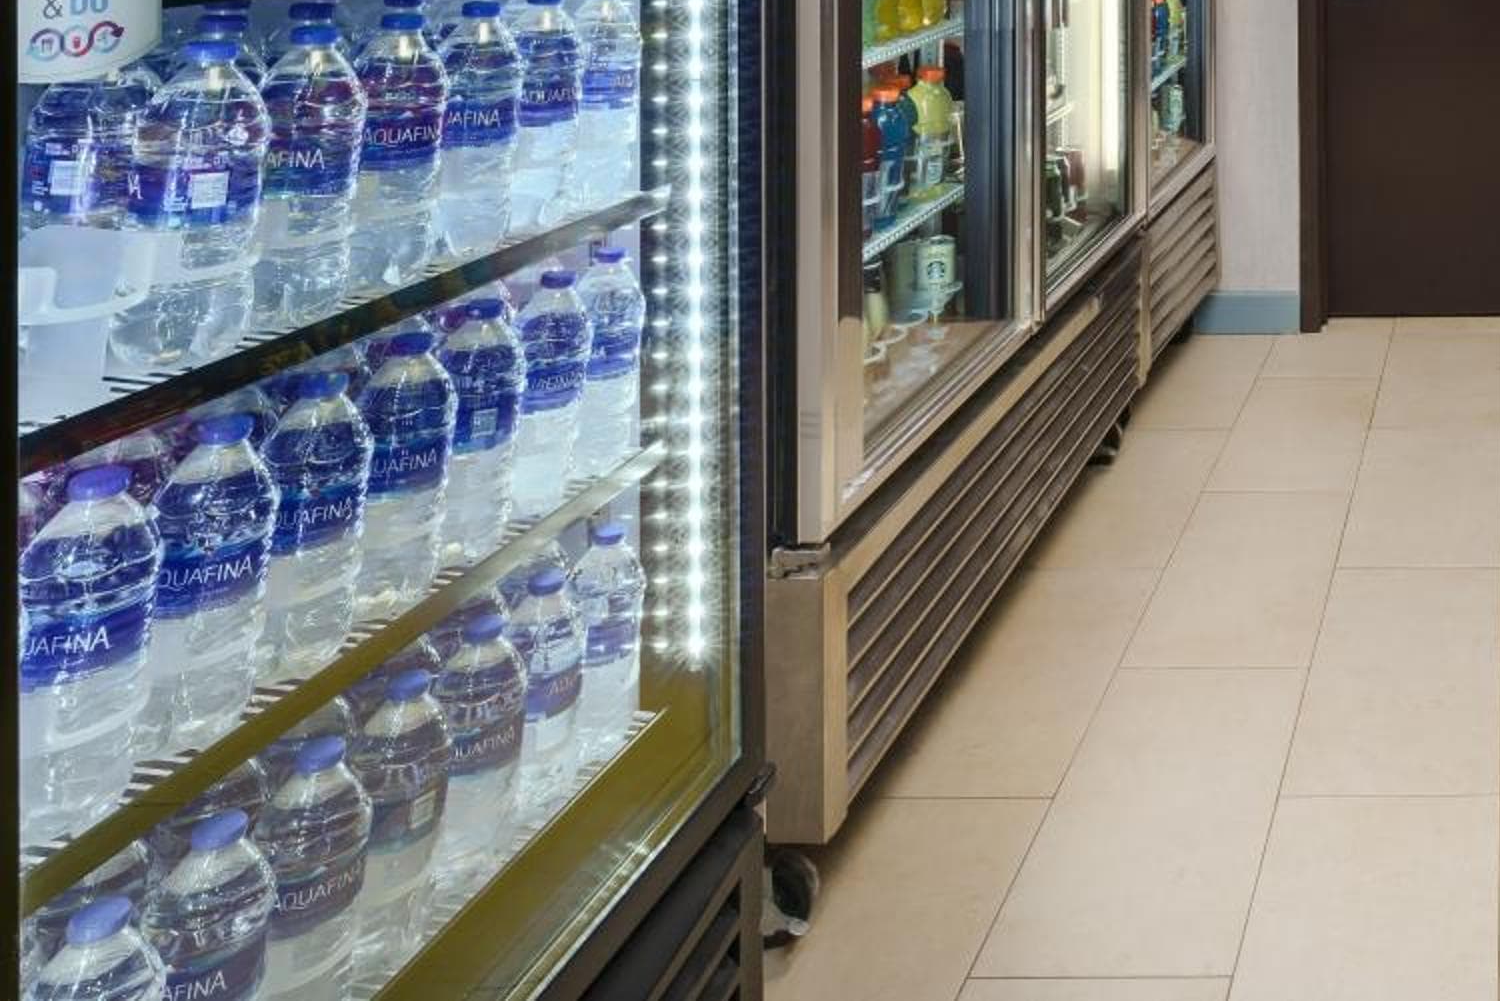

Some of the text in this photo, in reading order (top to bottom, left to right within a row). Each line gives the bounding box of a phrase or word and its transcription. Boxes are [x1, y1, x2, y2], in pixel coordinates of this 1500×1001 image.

[265, 147, 326, 172] AFINA
[372, 448, 438, 474] UAFINA
[156, 554, 254, 589] QUAFINA
[21, 626, 112, 659] UAFINA
[160, 969, 228, 1001] AFINA
